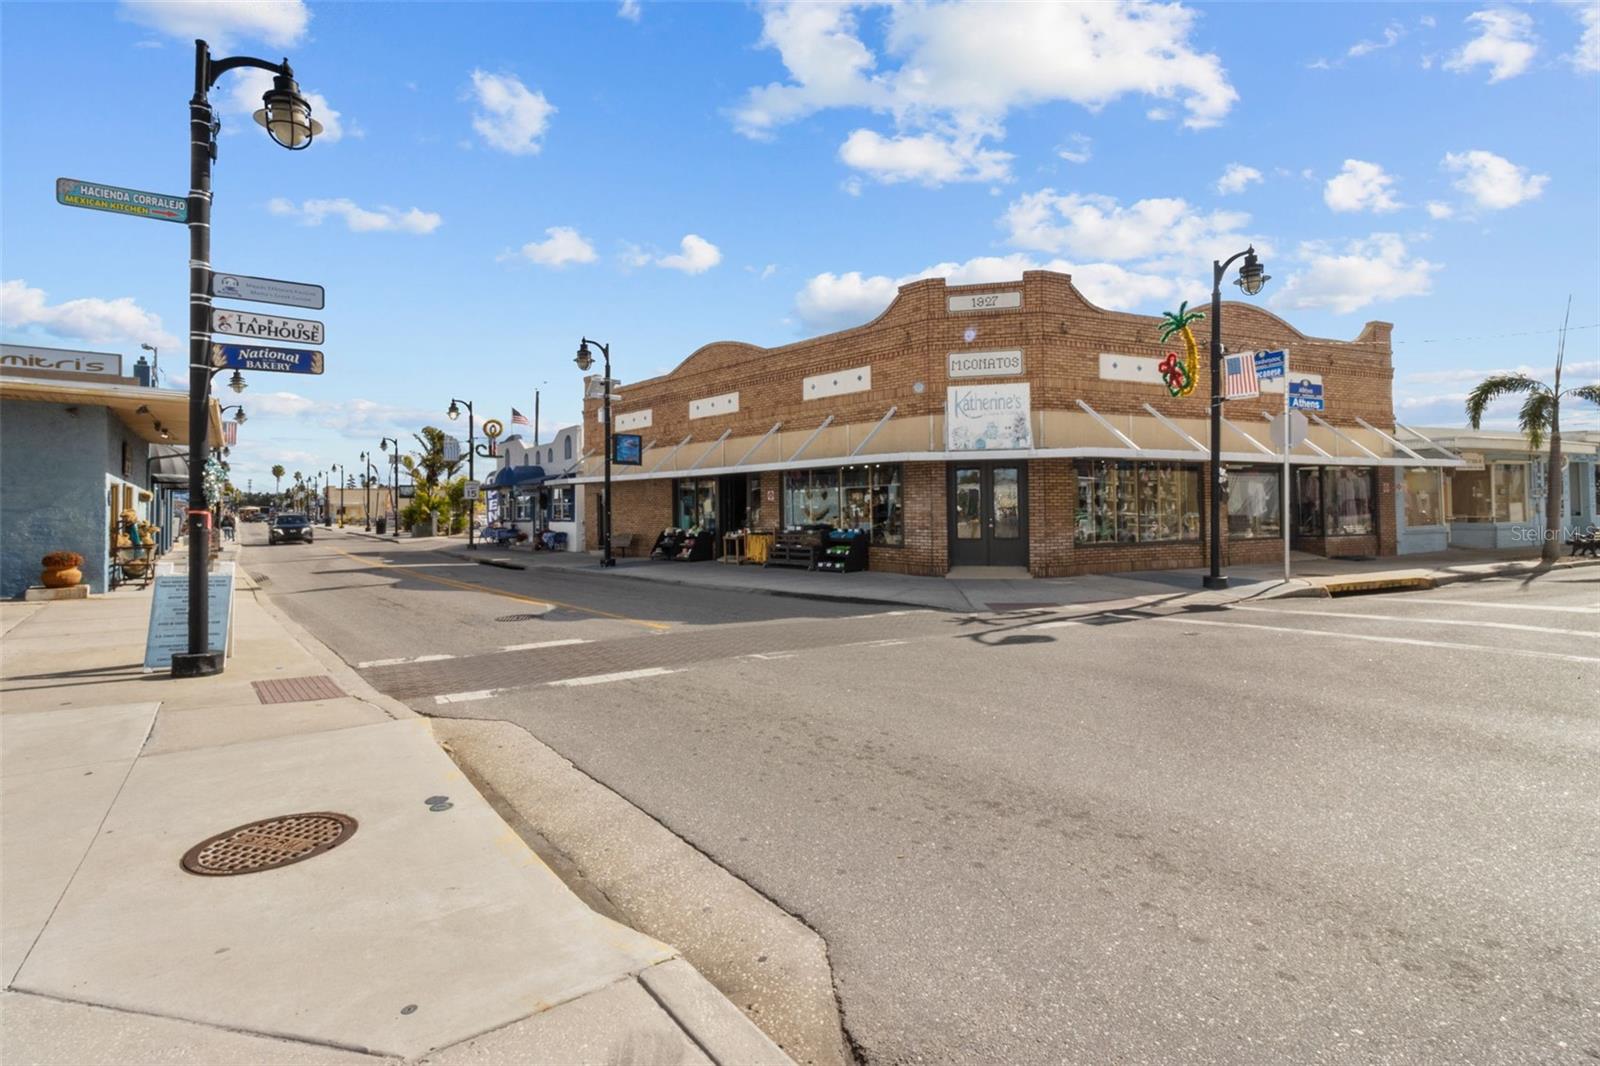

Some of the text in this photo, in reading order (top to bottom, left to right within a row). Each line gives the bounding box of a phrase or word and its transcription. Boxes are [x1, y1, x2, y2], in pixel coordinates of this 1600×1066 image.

[65, 195, 149, 214] MEXICAN KITCHEN
[80, 185, 185, 210] HACIENDA CORRALEJO
[971, 296, 998, 308] 1927
[236, 314, 320, 332] TARPON
[236, 322, 319, 341] TAPHOUSE
[238, 348, 299, 364] National
[246, 360, 291, 371] BAKERY
[954, 390, 1021, 419] Katherine's
[1293, 397, 1320, 409] Athens
[467, 490, 477, 498] 15
